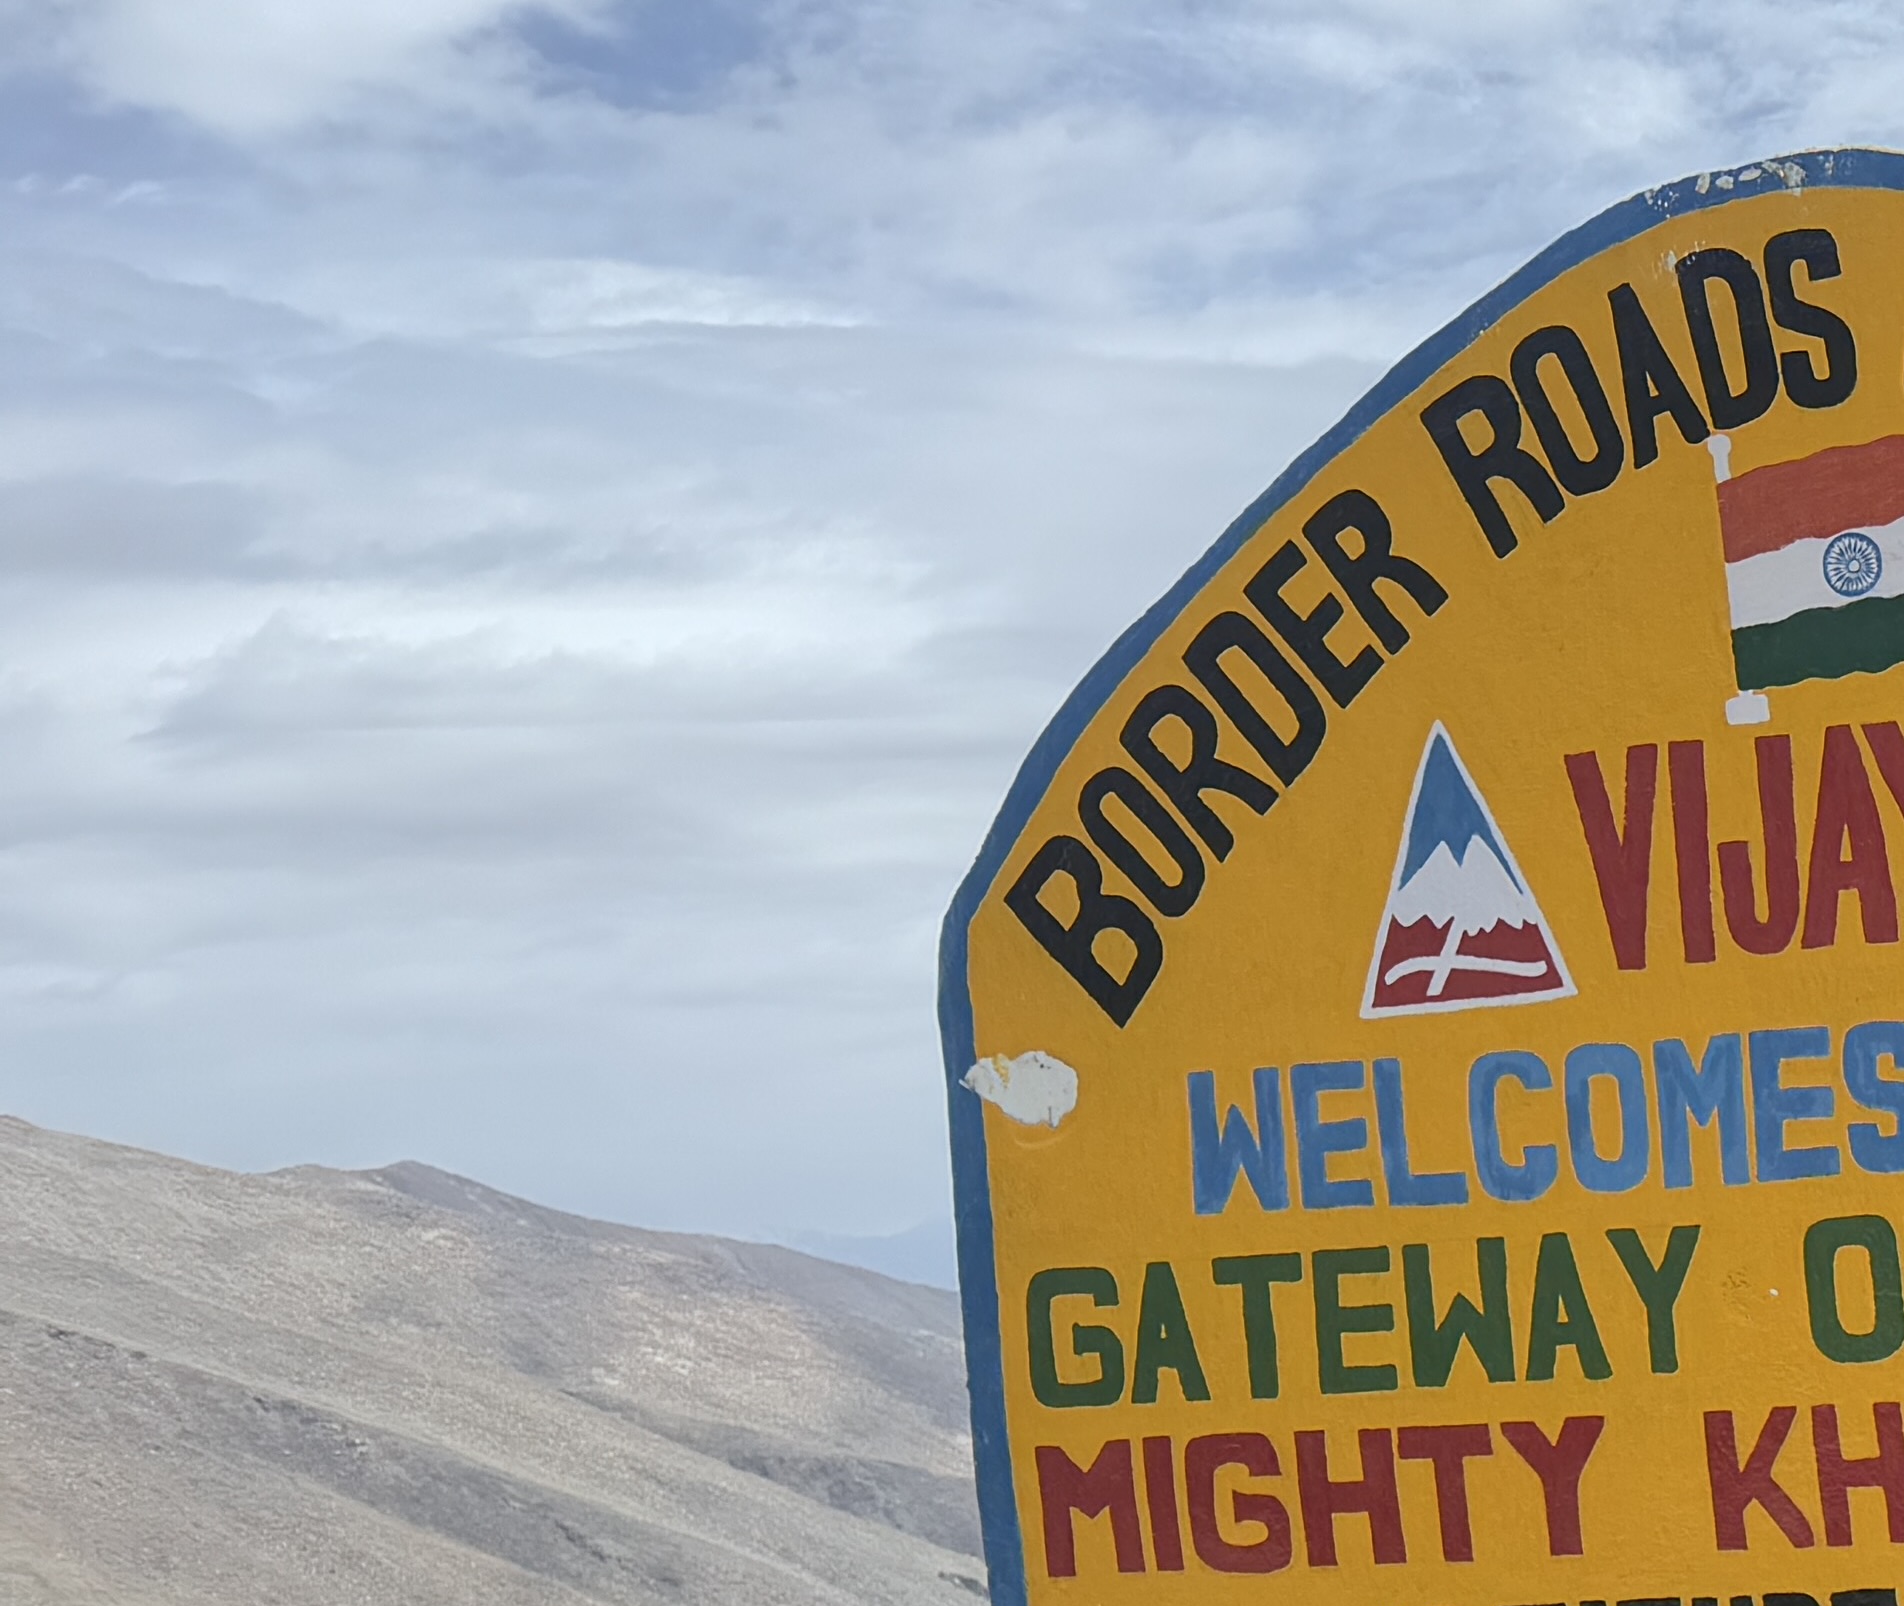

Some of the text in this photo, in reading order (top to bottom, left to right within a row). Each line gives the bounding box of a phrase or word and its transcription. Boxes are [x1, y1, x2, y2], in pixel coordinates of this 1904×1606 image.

[1003, 488, 1449, 1030] BORDER
[1419, 228, 1857, 558] ROADS
[1025, 1223, 1702, 1409] GATEWAY
[1034, 1416, 1605, 1578] MIGHTY
